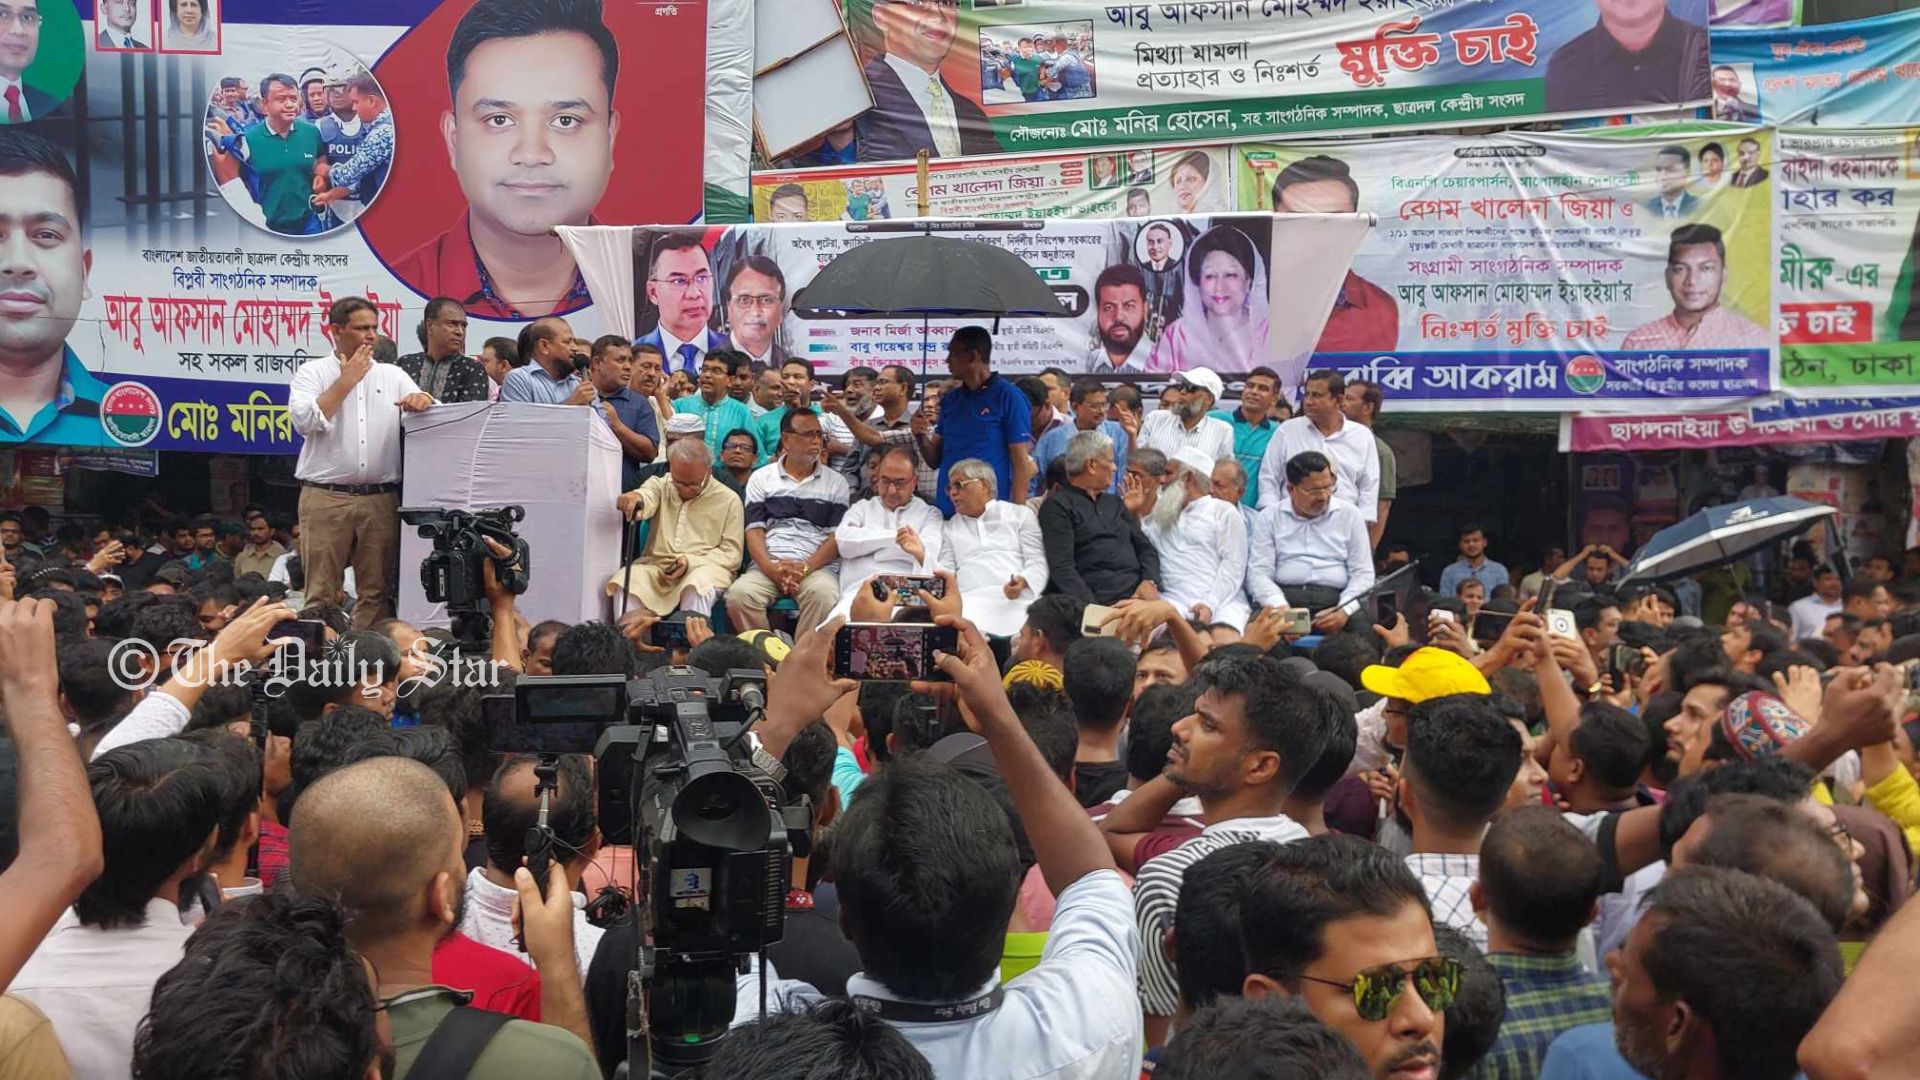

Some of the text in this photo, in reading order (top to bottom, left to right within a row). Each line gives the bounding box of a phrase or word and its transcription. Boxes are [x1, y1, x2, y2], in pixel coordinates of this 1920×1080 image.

[1105, 3, 1152, 31] আবু
[1133, 39, 1250, 66] মিথ্যা মামলা
[1335, 12, 1540, 87] মুক্তি চাই
[1136, 54, 1322, 91] প্রত্যাহার ও নিঃশর্ত
[1071, 118, 1108, 138] মোঃ
[1113, 110, 1159, 135] মনির
[1167, 109, 1237, 132] হোসেন,
[1241, 111, 1262, 126] সহ
[1265, 104, 1327, 125] সাংগঠনিক
[1331, 103, 1388, 120] সম্পাদক,
[1392, 100, 1436, 116] ছাত্রদল
[1441, 93, 1485, 112] কেন্দ্রীয়
[1489, 92, 1526, 108] সংসদ
[952, 179, 1003, 195] খালেদা
[1008, 174, 1046, 190] জিয়া
[1848, 187, 1896, 207] কর
[1399, 191, 1633, 221] বেগম খালেদা জিয়া ও
[142, 247, 348, 267] বাংলাদেশ জাতীয়তাবাদী ছাত্রদল কেন্দ্রীয় সংসদের
[1407, 253, 1625, 277] সংগ্রামী সাংগঠনিক সম্পাদক
[210, 267, 266, 290] সাংগঠনিক
[270, 273, 318, 291] সম্পাদক
[1398, 282, 1427, 308] আবু
[1431, 282, 1488, 304] আফসান
[1495, 282, 1553, 305] মোহাম্মদ
[103, 291, 145, 355] আবু
[147, 291, 227, 347] আফসান
[233, 291, 313, 348] মোহাম্মদ
[850, 326, 881, 336] জনাব
[885, 324, 912, 336] মির্জা
[1420, 309, 1609, 345] নিঃশর্ত মুক্তি চাই
[1806, 305, 1857, 335] চাই
[850, 342, 870, 353] বাবু
[177, 352, 203, 375] সহ
[208, 353, 248, 375] সকল
[1423, 359, 1559, 394] আকরাম
[1614, 354, 1750, 374] সাংগঠনিক সম্পাদক
[1847, 353, 1915, 377] ঢাকা
[168, 399, 219, 441] মোঃ
[227, 390, 293, 443] মনির
[1608, 416, 1721, 442] ছাগলনাইয়া
